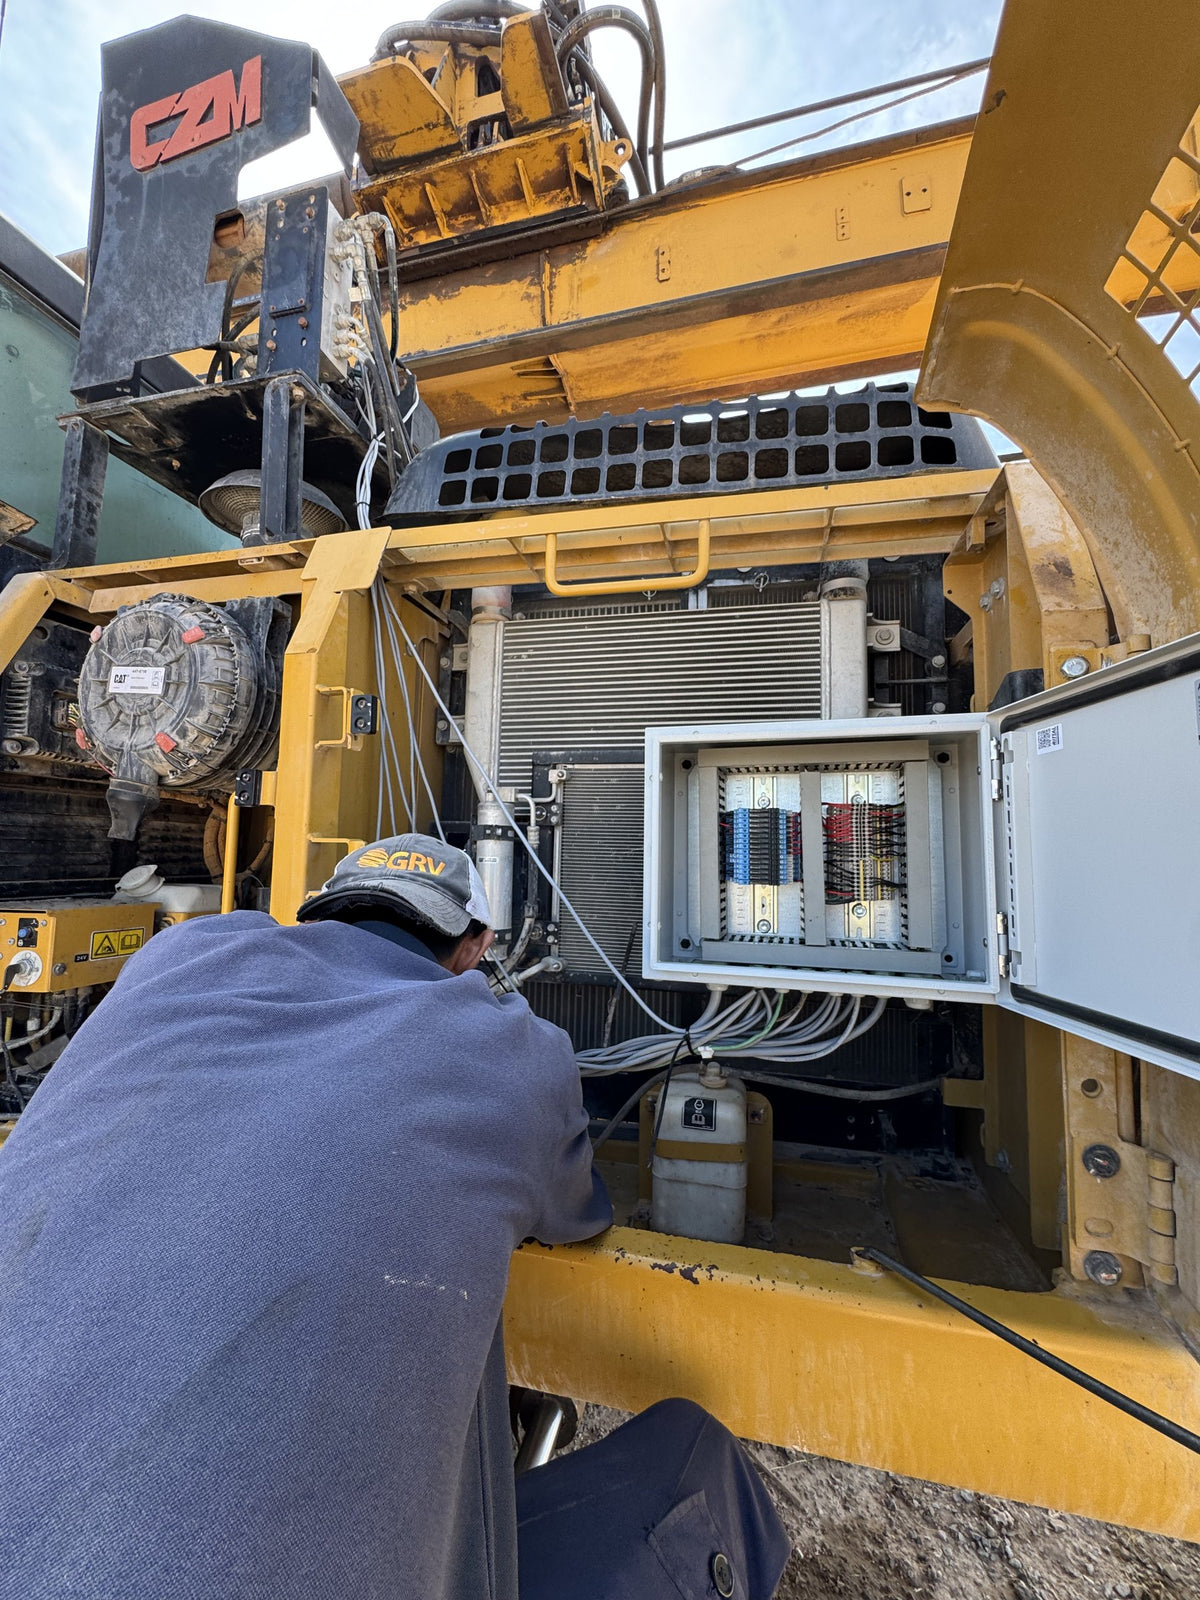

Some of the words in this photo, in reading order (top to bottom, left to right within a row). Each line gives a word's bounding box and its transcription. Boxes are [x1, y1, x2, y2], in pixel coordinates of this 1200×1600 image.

[130, 54, 262, 171] CZM
[113, 674, 128, 684] CAT
[386, 851, 446, 876] GRV
